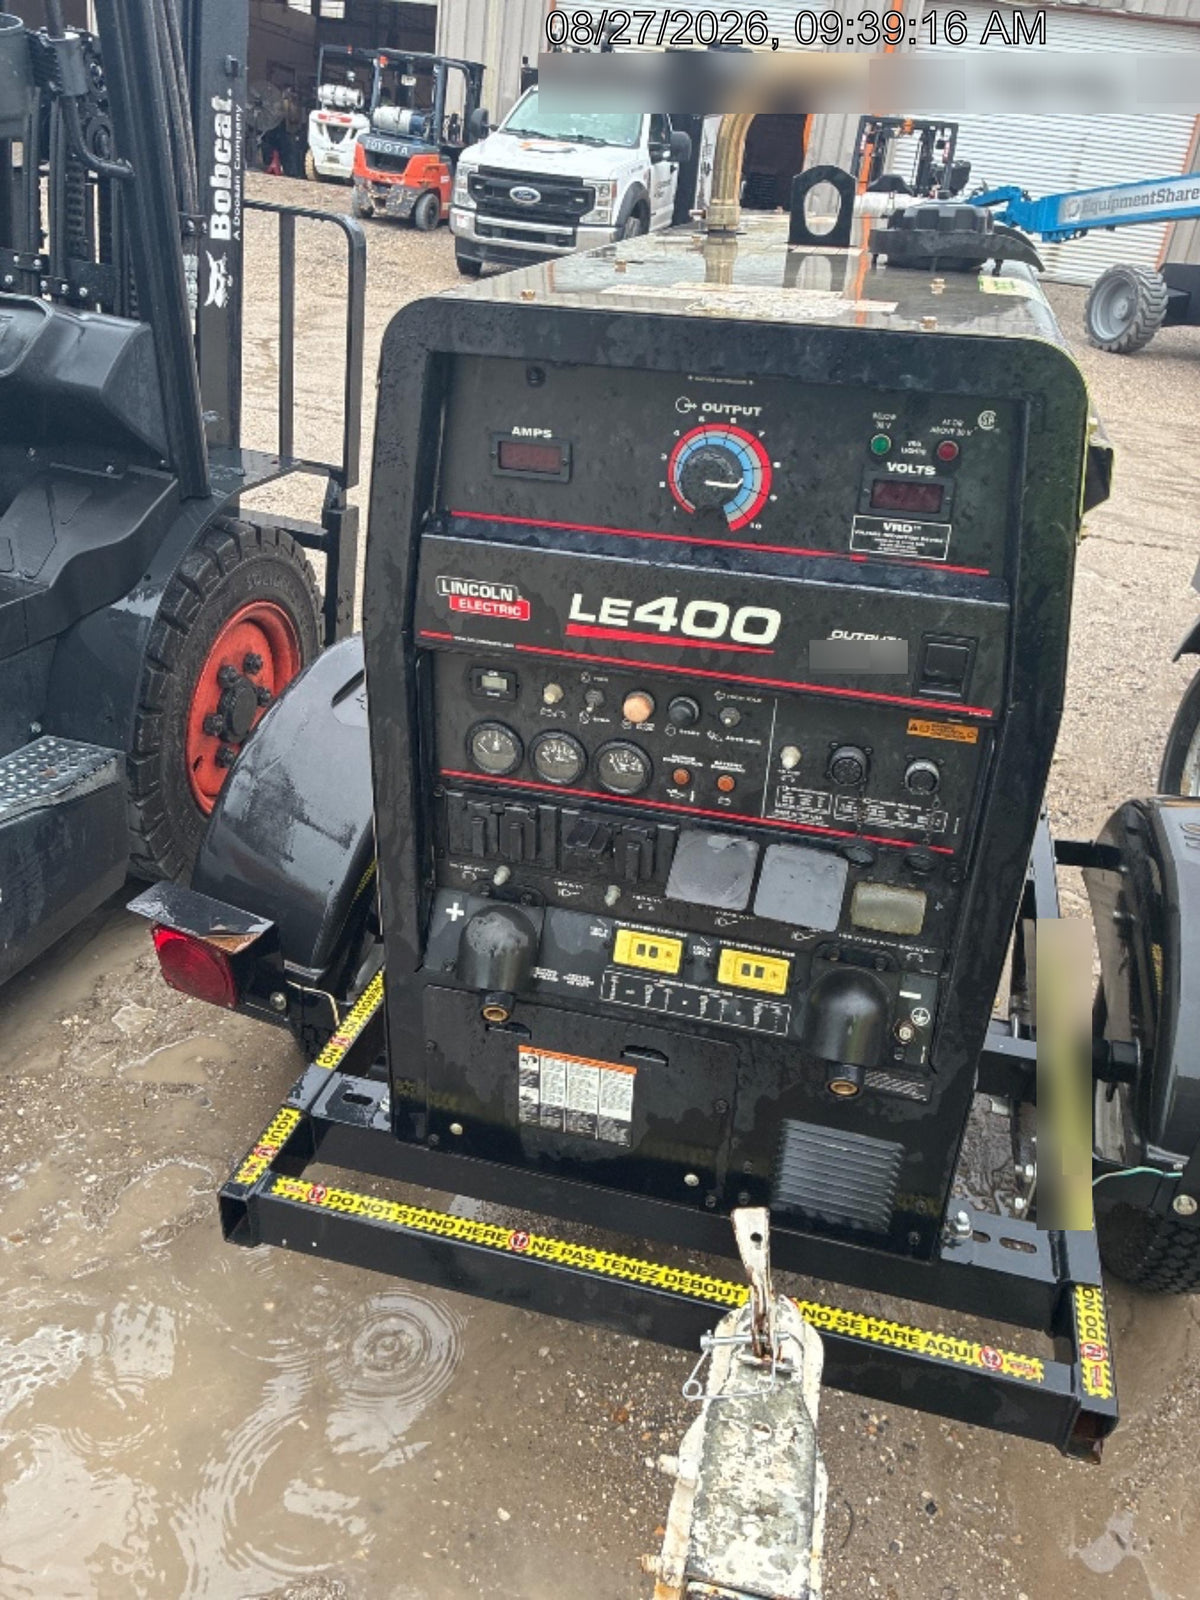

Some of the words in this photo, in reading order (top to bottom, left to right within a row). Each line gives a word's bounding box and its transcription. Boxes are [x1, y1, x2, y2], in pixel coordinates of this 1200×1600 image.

[233, 104, 244, 170] Company
[366, 139, 409, 155] TOYOTA
[209, 95, 233, 241] Bobcat
[232, 175, 241, 225] Doosan
[1081, 187, 1200, 216] EquipmentShare
[232, 231, 241, 241] A
[701, 402, 763, 417] OUTPUT
[511, 425, 553, 439] AMPS
[886, 461, 937, 476] VOLTS
[441, 578, 514, 602] LINCOLN
[457, 597, 522, 617] ELECTRIC
[568, 591, 782, 646] LE400
[327, 1193, 355, 1206] DO
[358, 1200, 394, 1216] NOT
[396, 1210, 456, 1230] STAND
[458, 1223, 508, 1242] HERE
[532, 1240, 556, 1254] NE
[559, 1246, 597, 1264] PAS
[600, 1257, 662, 1279] TENEZ
[663, 1272, 744, 1301] DEBOUT
[801, 1307, 832, 1323] NO
[836, 1315, 863, 1332] SE
[867, 1321, 920, 1346] PARE
[1084, 1315, 1099, 1340] DO
